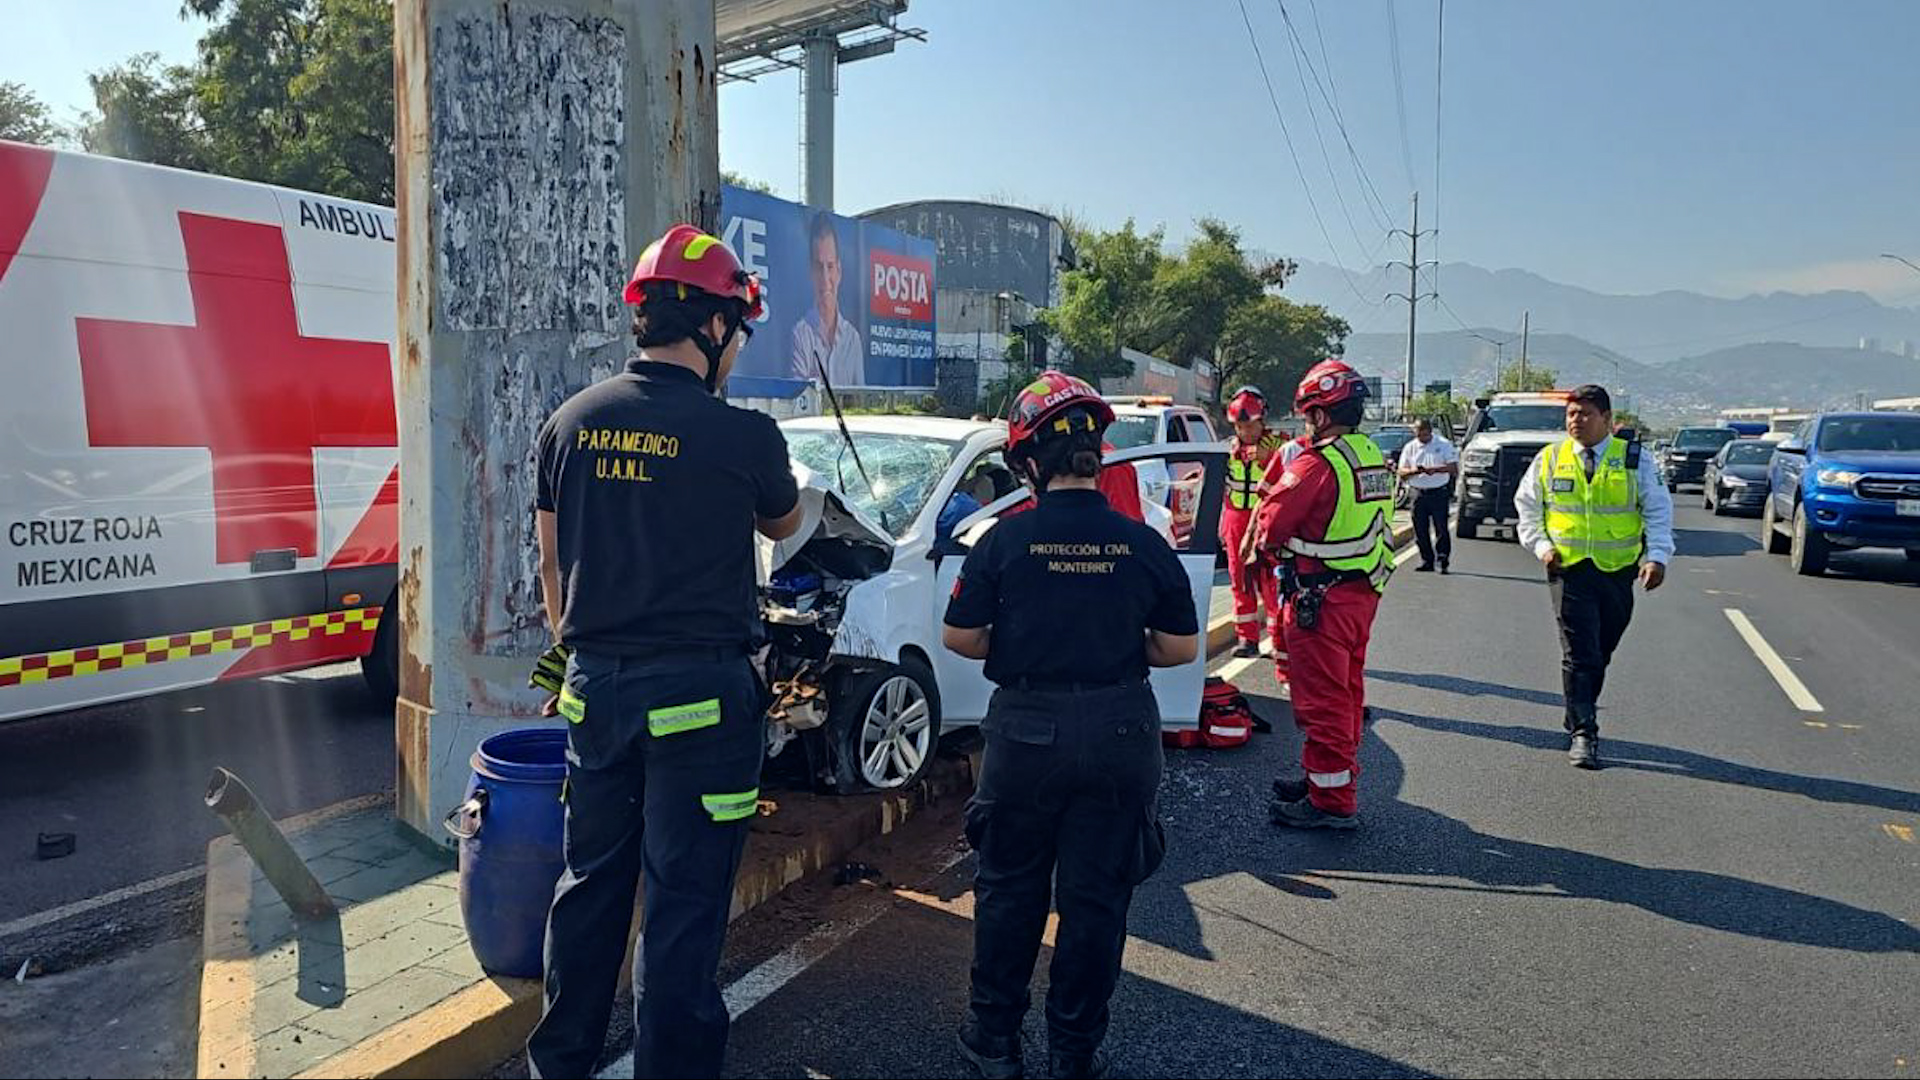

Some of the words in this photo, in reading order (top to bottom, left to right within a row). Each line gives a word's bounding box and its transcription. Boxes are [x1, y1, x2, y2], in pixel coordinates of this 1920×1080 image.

[299, 199, 397, 243] AMBUL
[874, 262, 929, 305] POSTA
[870, 341, 880, 356] EN
[577, 428, 680, 458] PARAMEDICO
[596, 457, 653, 482] U.A.N.L.
[9, 520, 86, 547] CRUZ
[94, 516, 162, 542] ROJA
[1104, 543, 1132, 556] CIVIL
[17, 553, 157, 587] MEXICANA
[1048, 561, 1116, 574] MONTERREY
